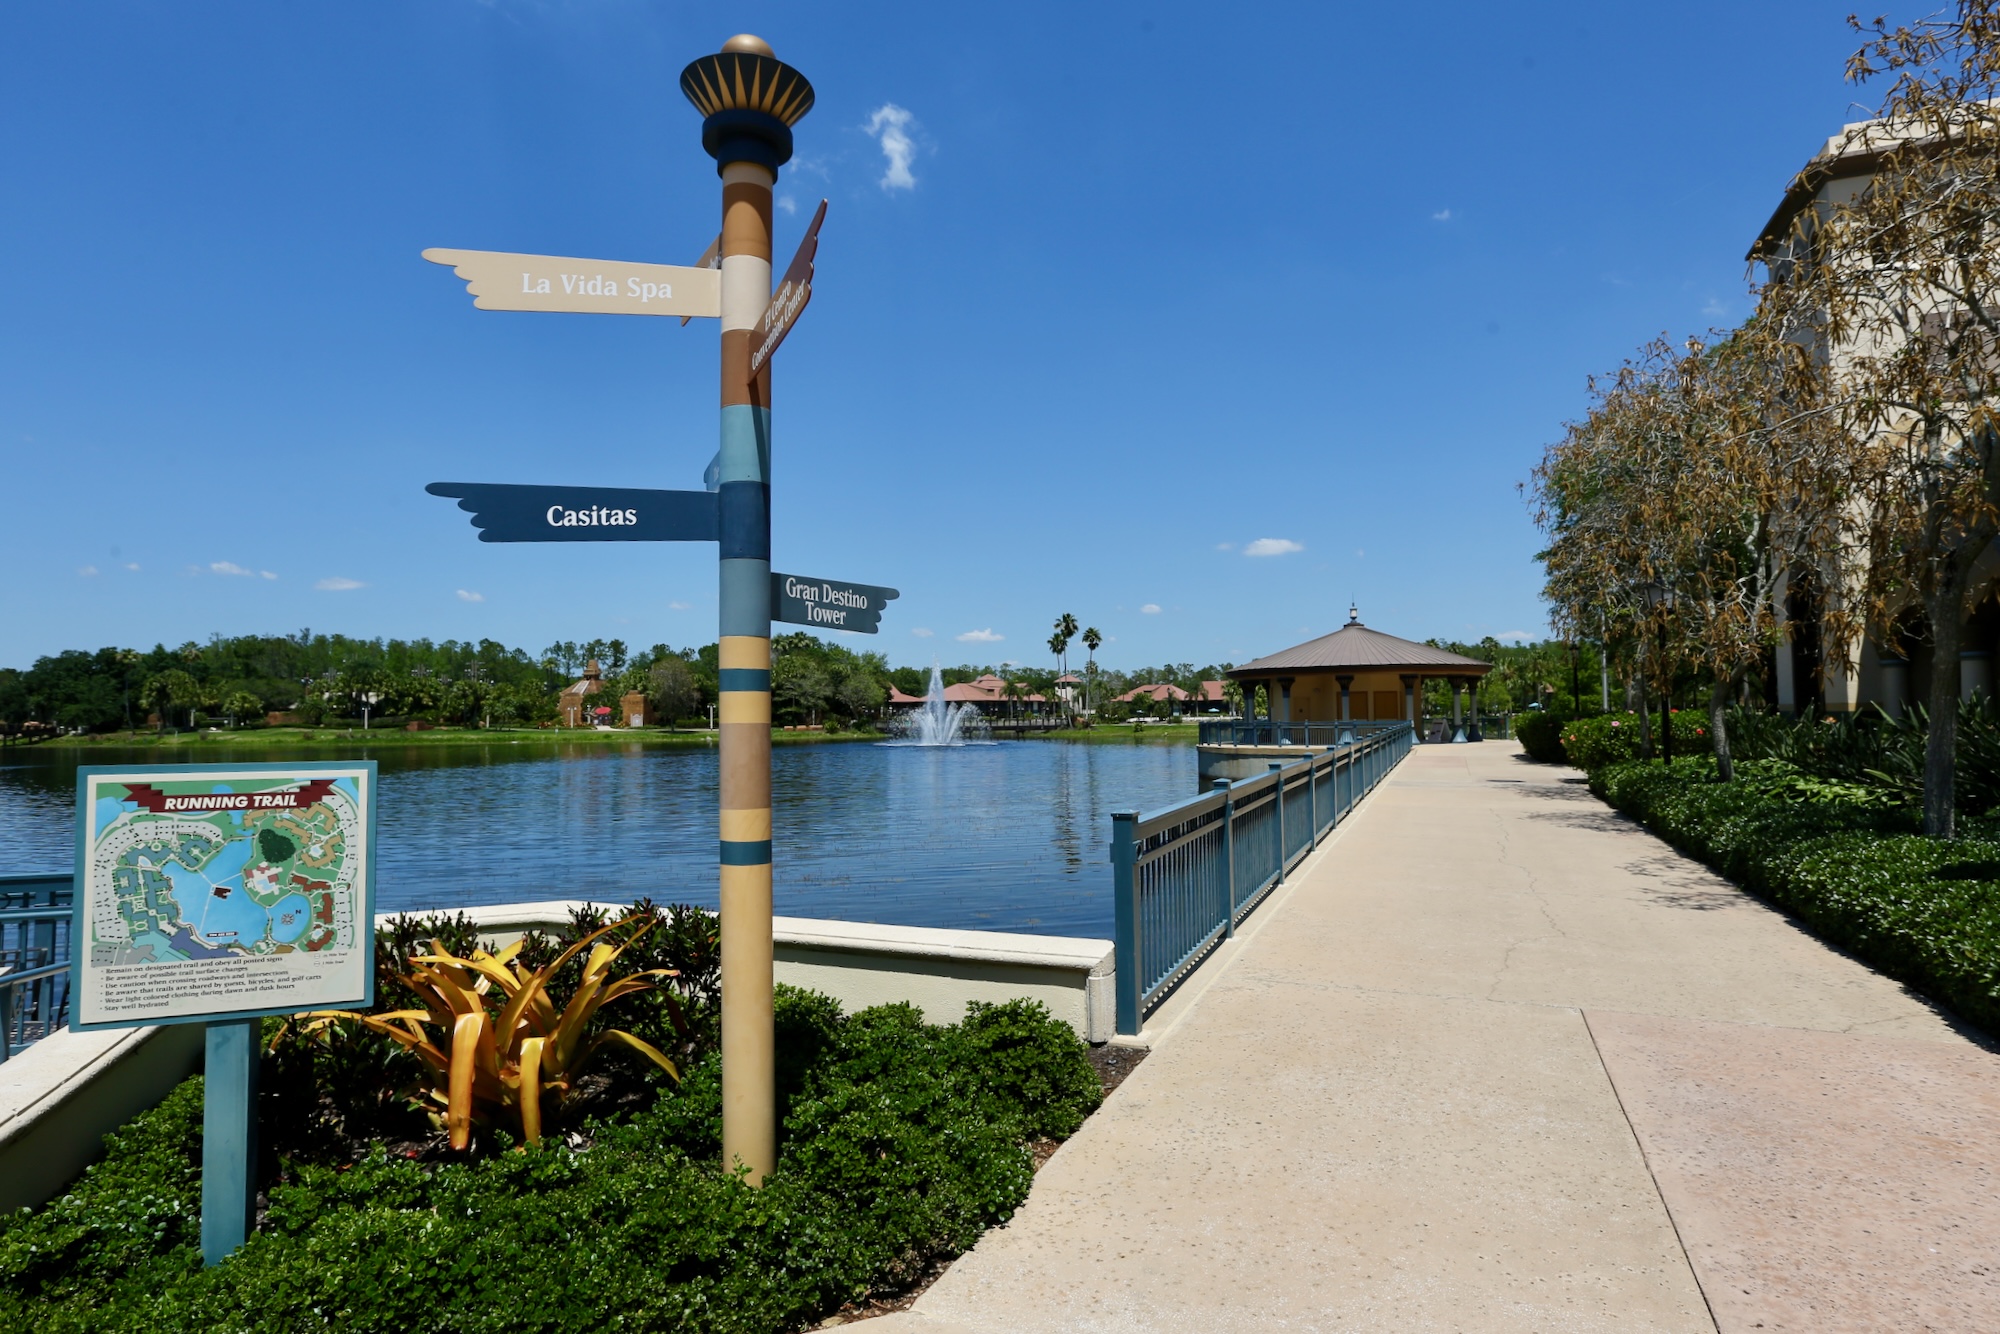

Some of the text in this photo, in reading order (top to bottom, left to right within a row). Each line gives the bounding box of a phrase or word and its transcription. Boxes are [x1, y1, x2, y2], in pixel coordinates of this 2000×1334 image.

[522, 273, 672, 302] La Vida Spa
[772, 281, 792, 321] Centro
[752, 278, 805, 371] Convention Center
[546, 504, 638, 527] Casitas
[785, 577, 868, 610] Gran Destino
[805, 601, 847, 625] Tower
[164, 795, 298, 810] RUNNING TRAIL
[145, 963, 182, 972] designated
[243, 957, 265, 965] posted
[150, 971, 177, 979] possible
[198, 974, 231, 982] roadways
[246, 970, 289, 978] intersections
[171, 991, 199, 999] clothing
[200, 989, 223, 997] during
[104, 1004, 120, 1012] Stay
[138, 1000, 170, 1009] hydrated
